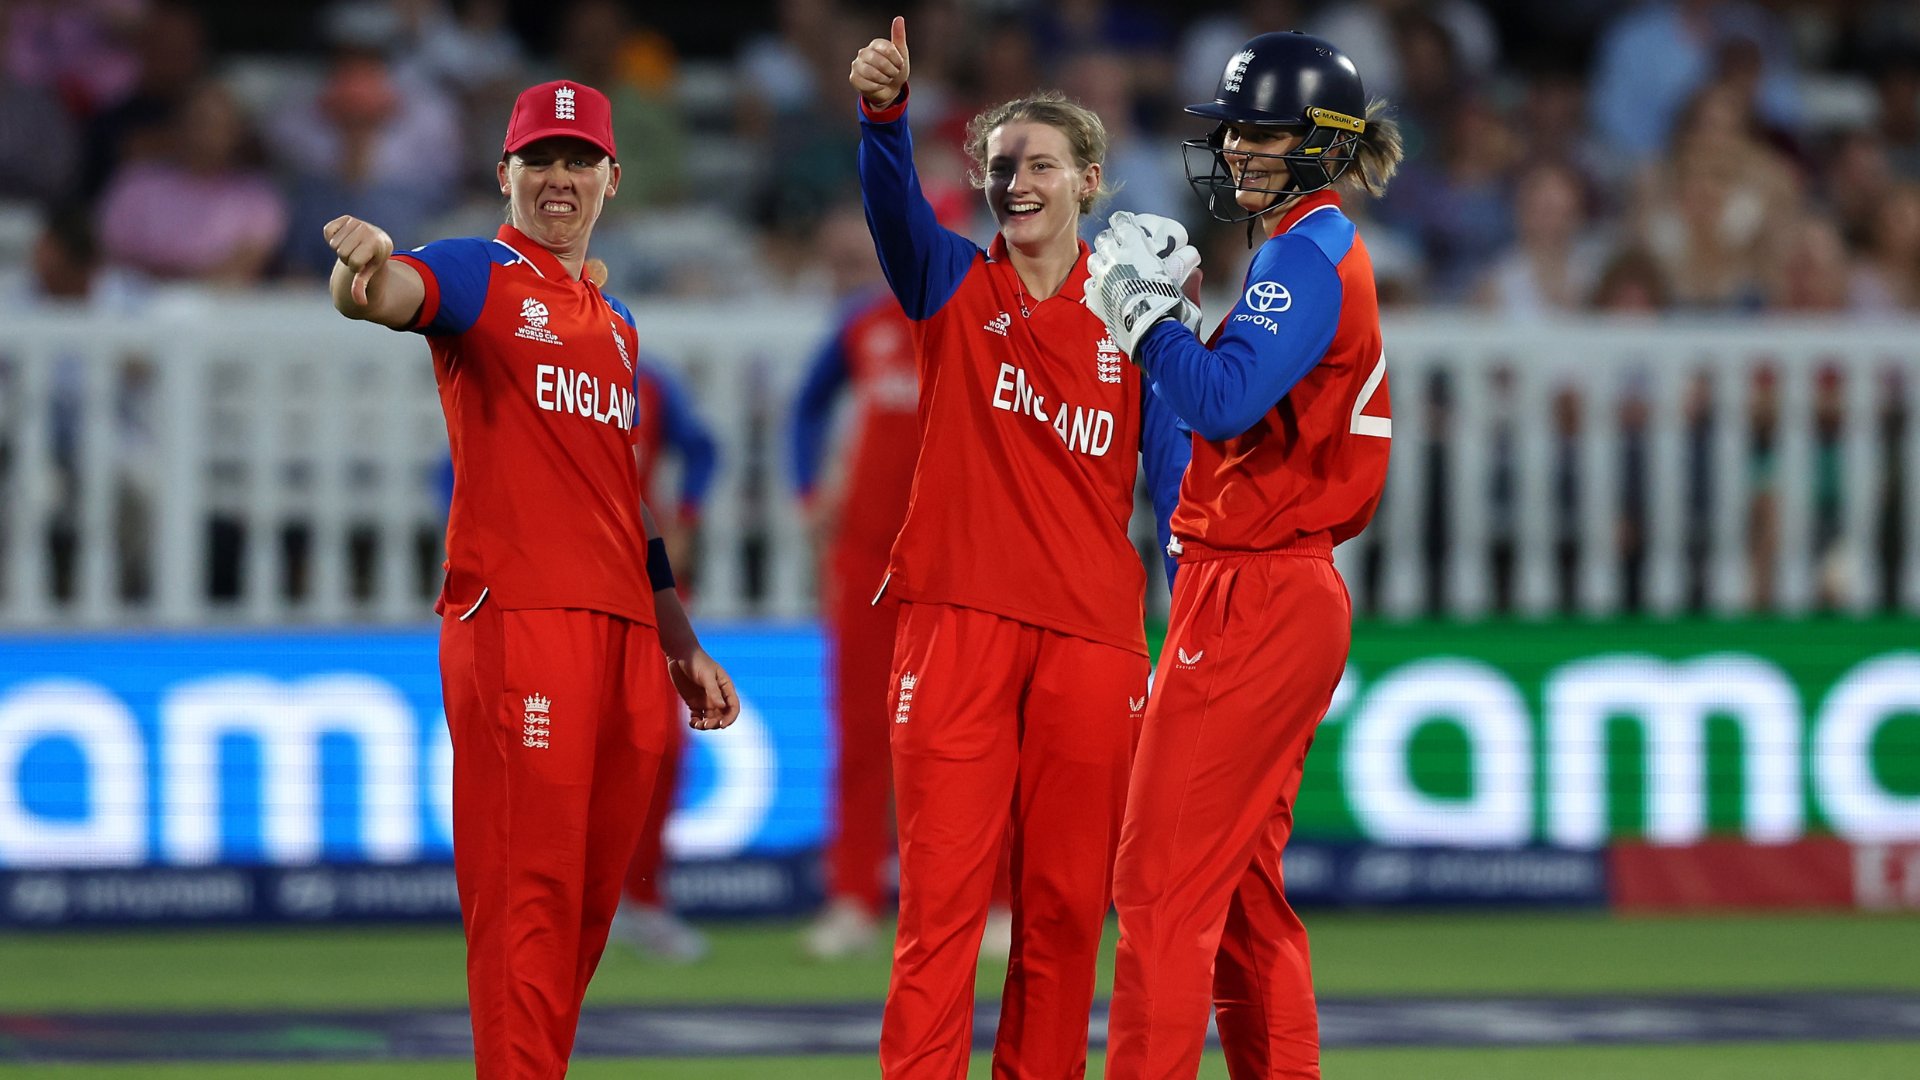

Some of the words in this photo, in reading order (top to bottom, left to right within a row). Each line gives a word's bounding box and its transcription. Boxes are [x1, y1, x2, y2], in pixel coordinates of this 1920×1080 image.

[1322, 112, 1351, 124] MASURI
[530, 320, 543, 328] ICC
[1233, 314, 1278, 335] TOYOTA
[514, 332, 536, 340] ENGLAND
[518, 327, 544, 338] WORLD
[544, 333, 558, 341] CUP
[992, 362, 1114, 457] ENAND
